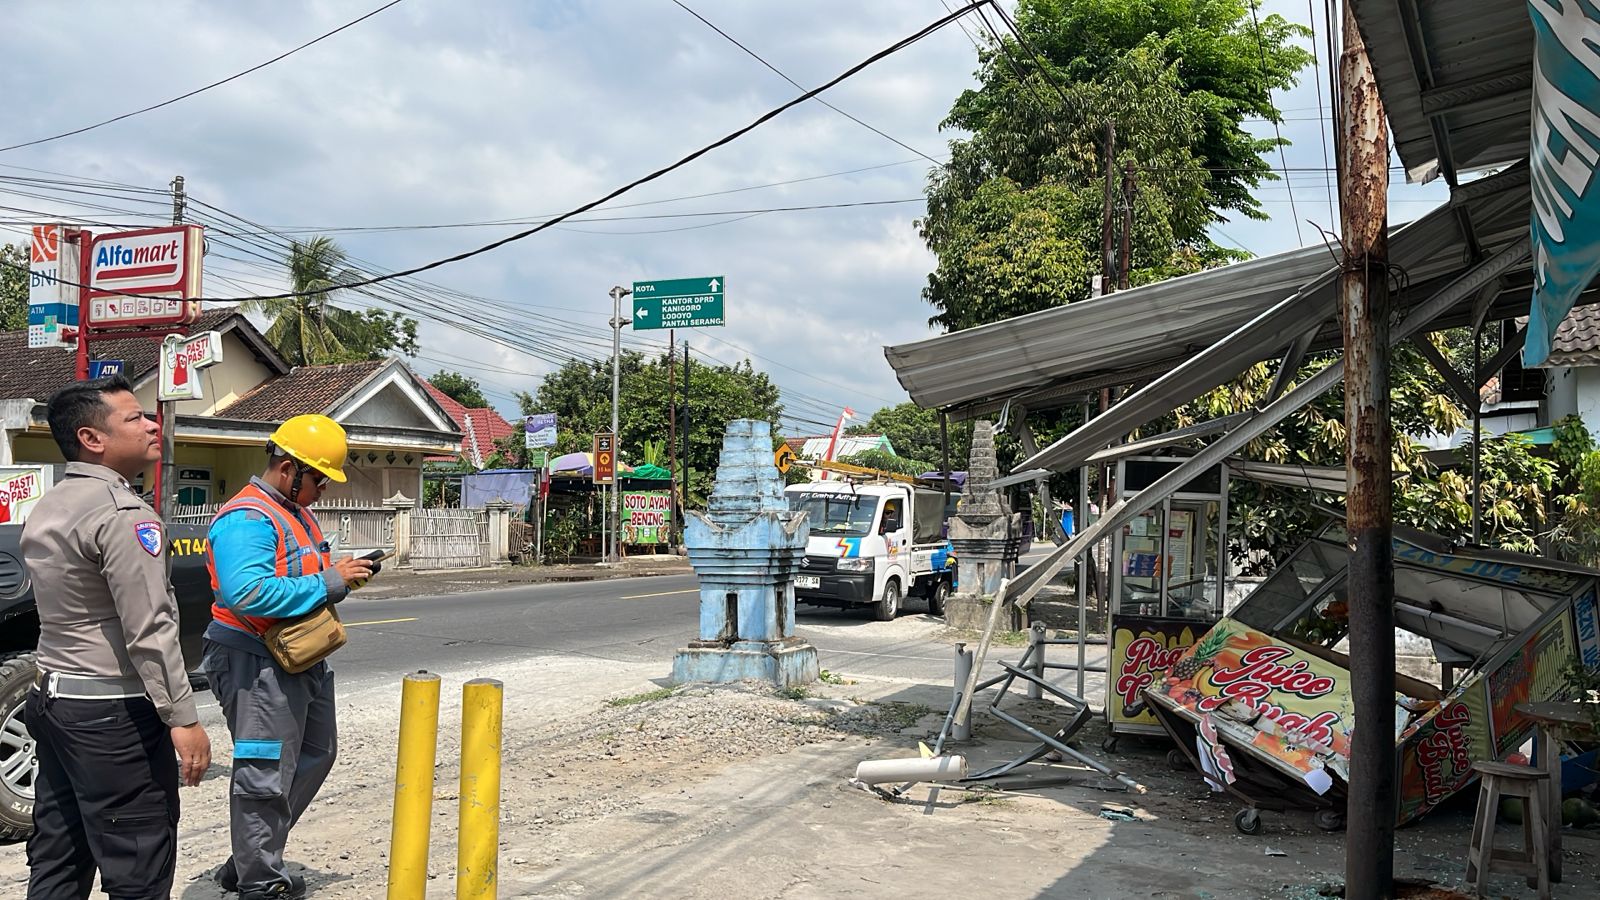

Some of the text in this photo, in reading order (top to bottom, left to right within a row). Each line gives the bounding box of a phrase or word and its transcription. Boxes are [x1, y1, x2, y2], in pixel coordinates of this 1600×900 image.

[96, 239, 179, 267] Alfamart
[31, 268, 57, 288] BNI
[662, 297, 692, 305] KANTOR
[31, 306, 45, 314] ATM
[662, 312, 692, 320] LODOYO
[186, 337, 209, 354] PASTI
[187, 349, 205, 365] PAS!
[101, 365, 119, 375] ATM
[9, 474, 34, 492] PASTI
[11, 487, 32, 502] PAS!
[625, 495, 671, 510] SOTO AYAM
[631, 512, 664, 526] BENING
[1121, 637, 1190, 674] Pisa
[1209, 645, 1335, 698] Juice
[1433, 703, 1472, 775] Juice
[1417, 731, 1453, 804] Buah
